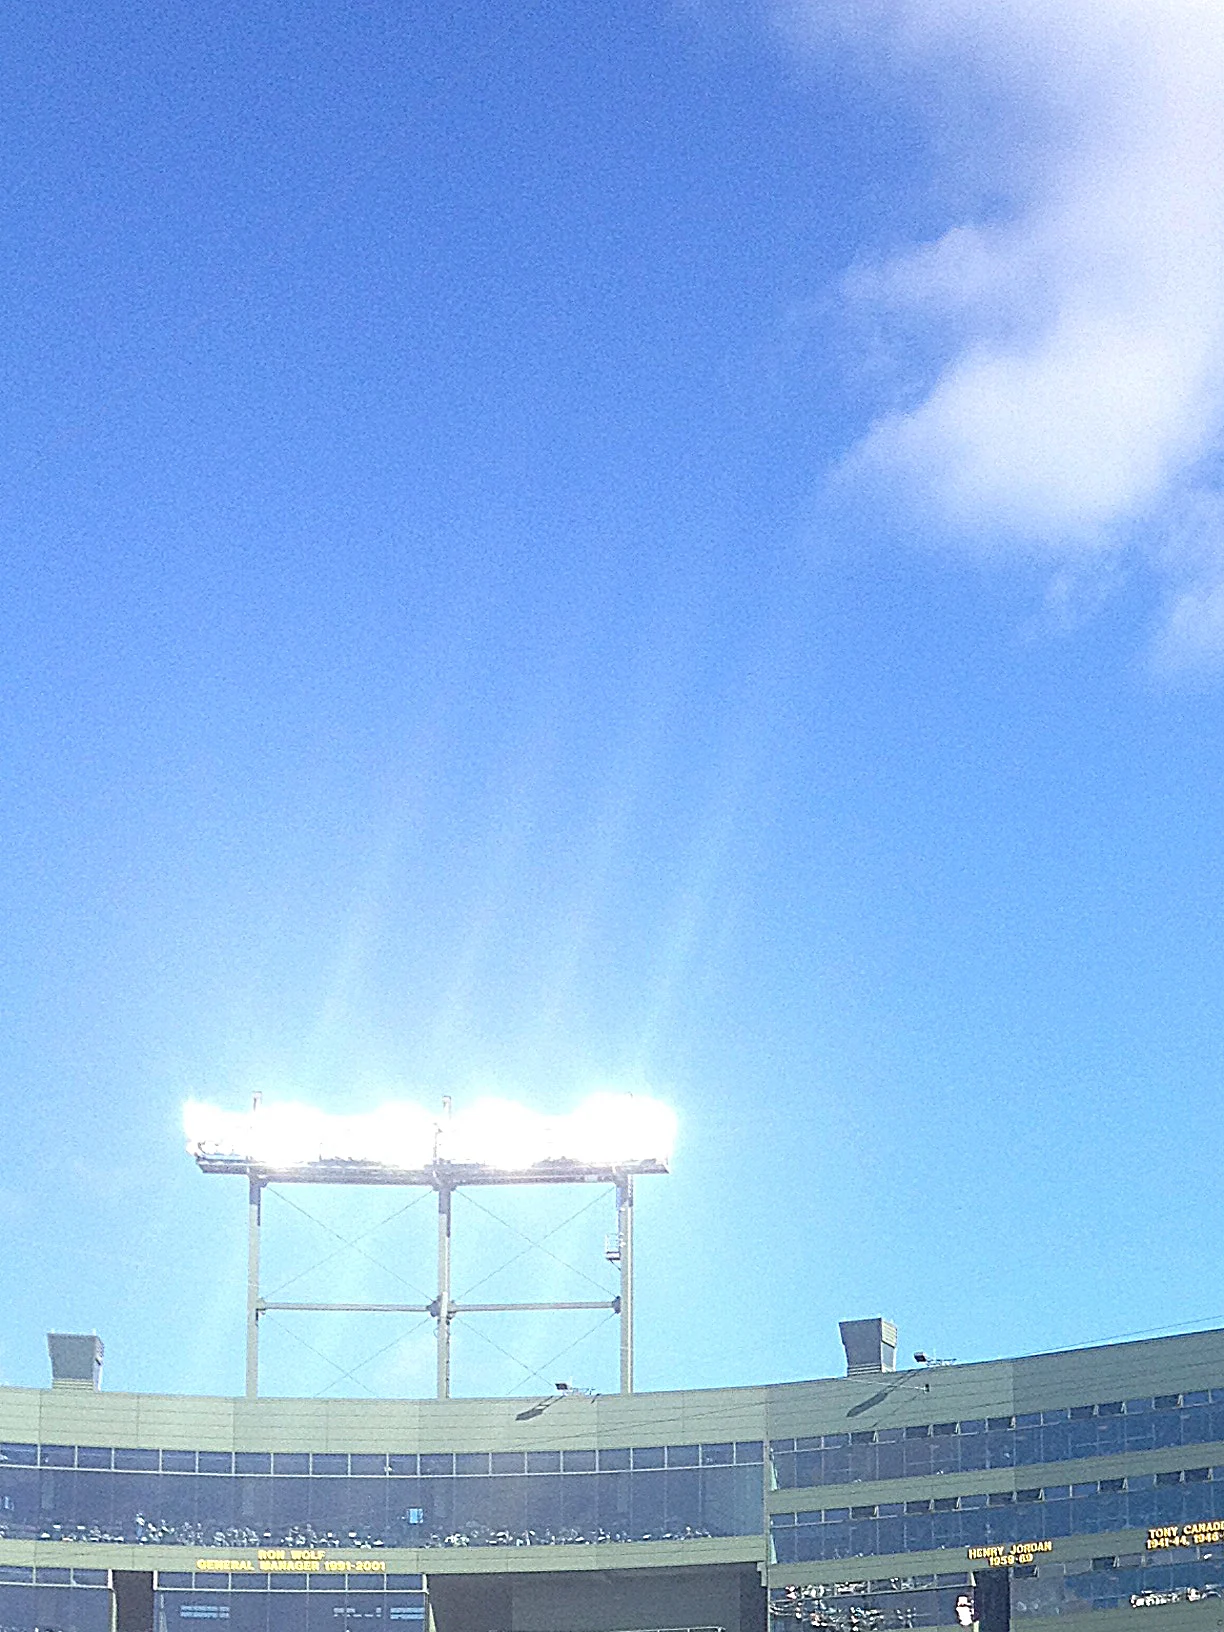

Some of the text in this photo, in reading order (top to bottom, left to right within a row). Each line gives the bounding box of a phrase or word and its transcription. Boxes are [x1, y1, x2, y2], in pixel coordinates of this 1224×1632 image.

[1148, 1526, 1178, 1539] TONY
[258, 1550, 325, 1560] RON WOLF
[968, 1541, 1052, 1560] HENRY JORDAN
[196, 1559, 254, 1571] GENERAL
[260, 1561, 320, 1571] MANAGER
